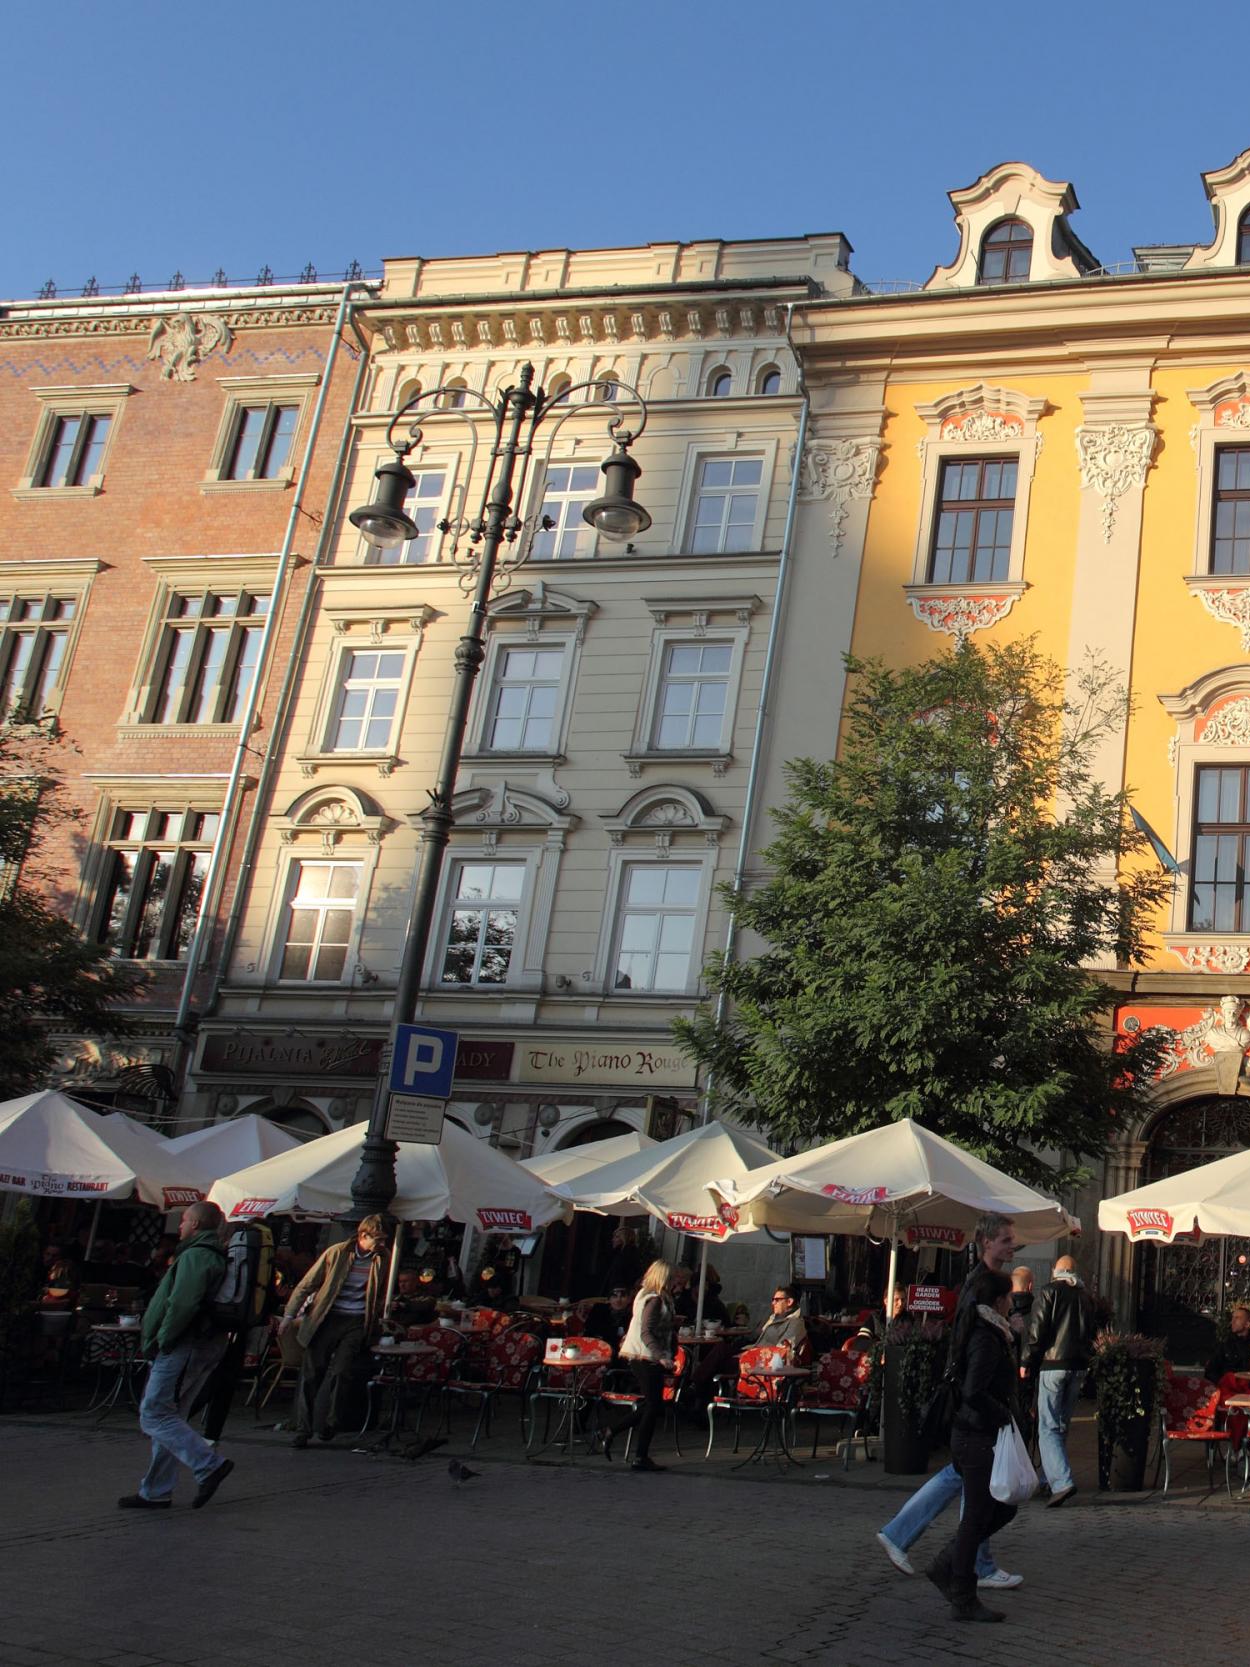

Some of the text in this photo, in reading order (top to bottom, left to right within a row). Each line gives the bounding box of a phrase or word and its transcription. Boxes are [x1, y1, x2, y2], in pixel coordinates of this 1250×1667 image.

[403, 1033, 443, 1086] P
[528, 1051, 566, 1070] The
[572, 1050, 631, 1077] Piano
